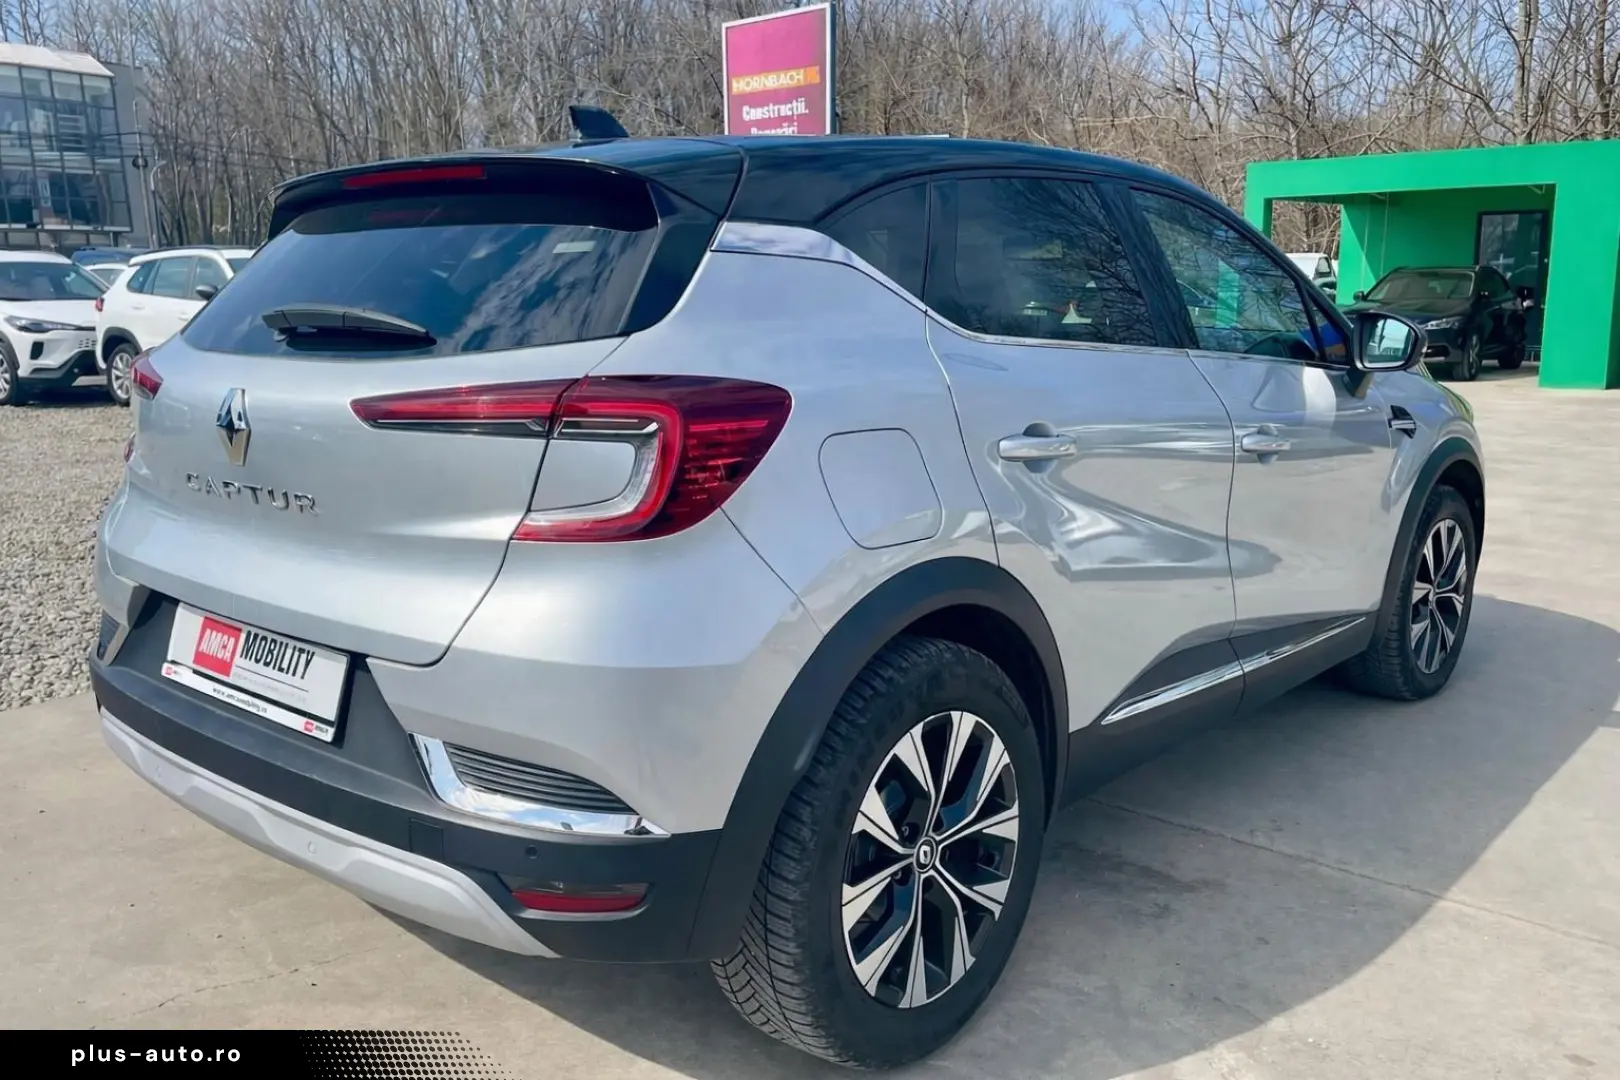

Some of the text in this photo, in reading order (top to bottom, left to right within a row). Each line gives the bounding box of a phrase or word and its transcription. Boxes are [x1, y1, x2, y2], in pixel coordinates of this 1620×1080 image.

[732, 68, 804, 92] HORNBACH
[186, 472, 320, 516] CAPTUR
[201, 627, 315, 680] AMCA MOBILITY
